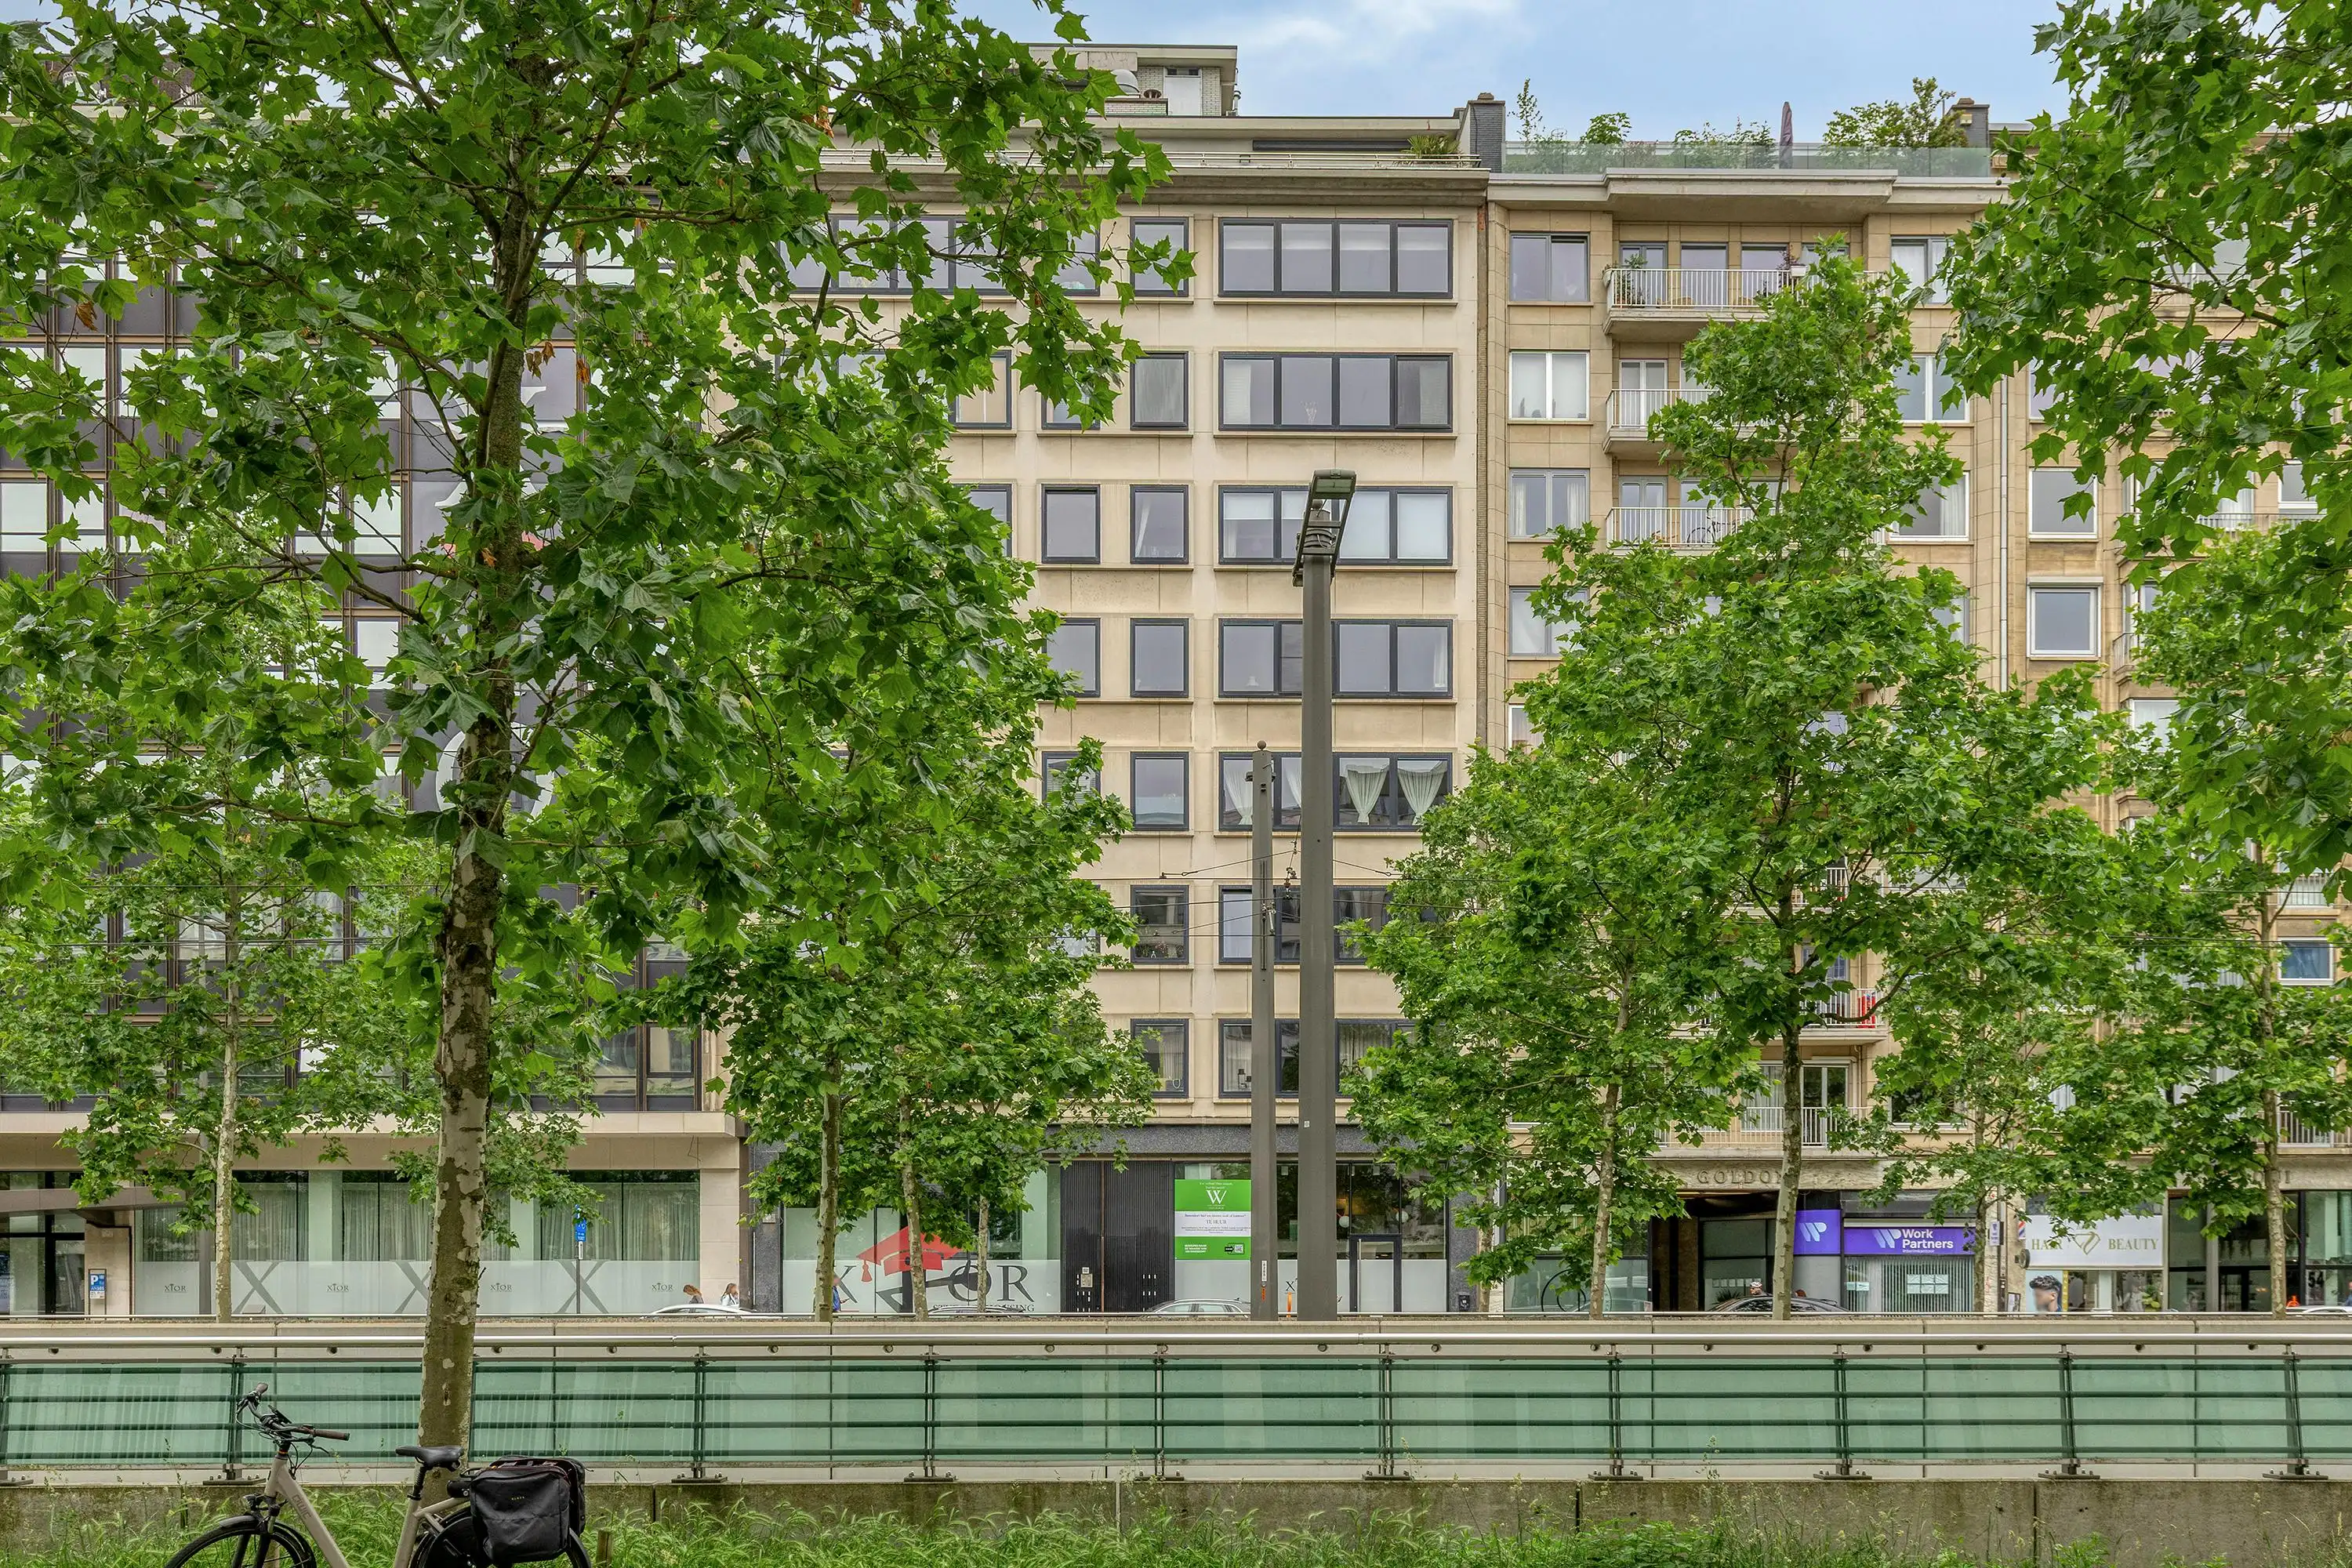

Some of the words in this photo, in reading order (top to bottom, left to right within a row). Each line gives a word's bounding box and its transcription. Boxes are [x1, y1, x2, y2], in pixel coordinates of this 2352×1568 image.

[1902, 1229, 1933, 1239] Work
[1902, 1239, 1954, 1249] Partners
[2032, 1239, 2063, 1250] HAR
[2109, 1239, 2158, 1250] BEAUTY
[90, 1275, 99, 1286] P
[2308, 1271, 2325, 1288] 54
